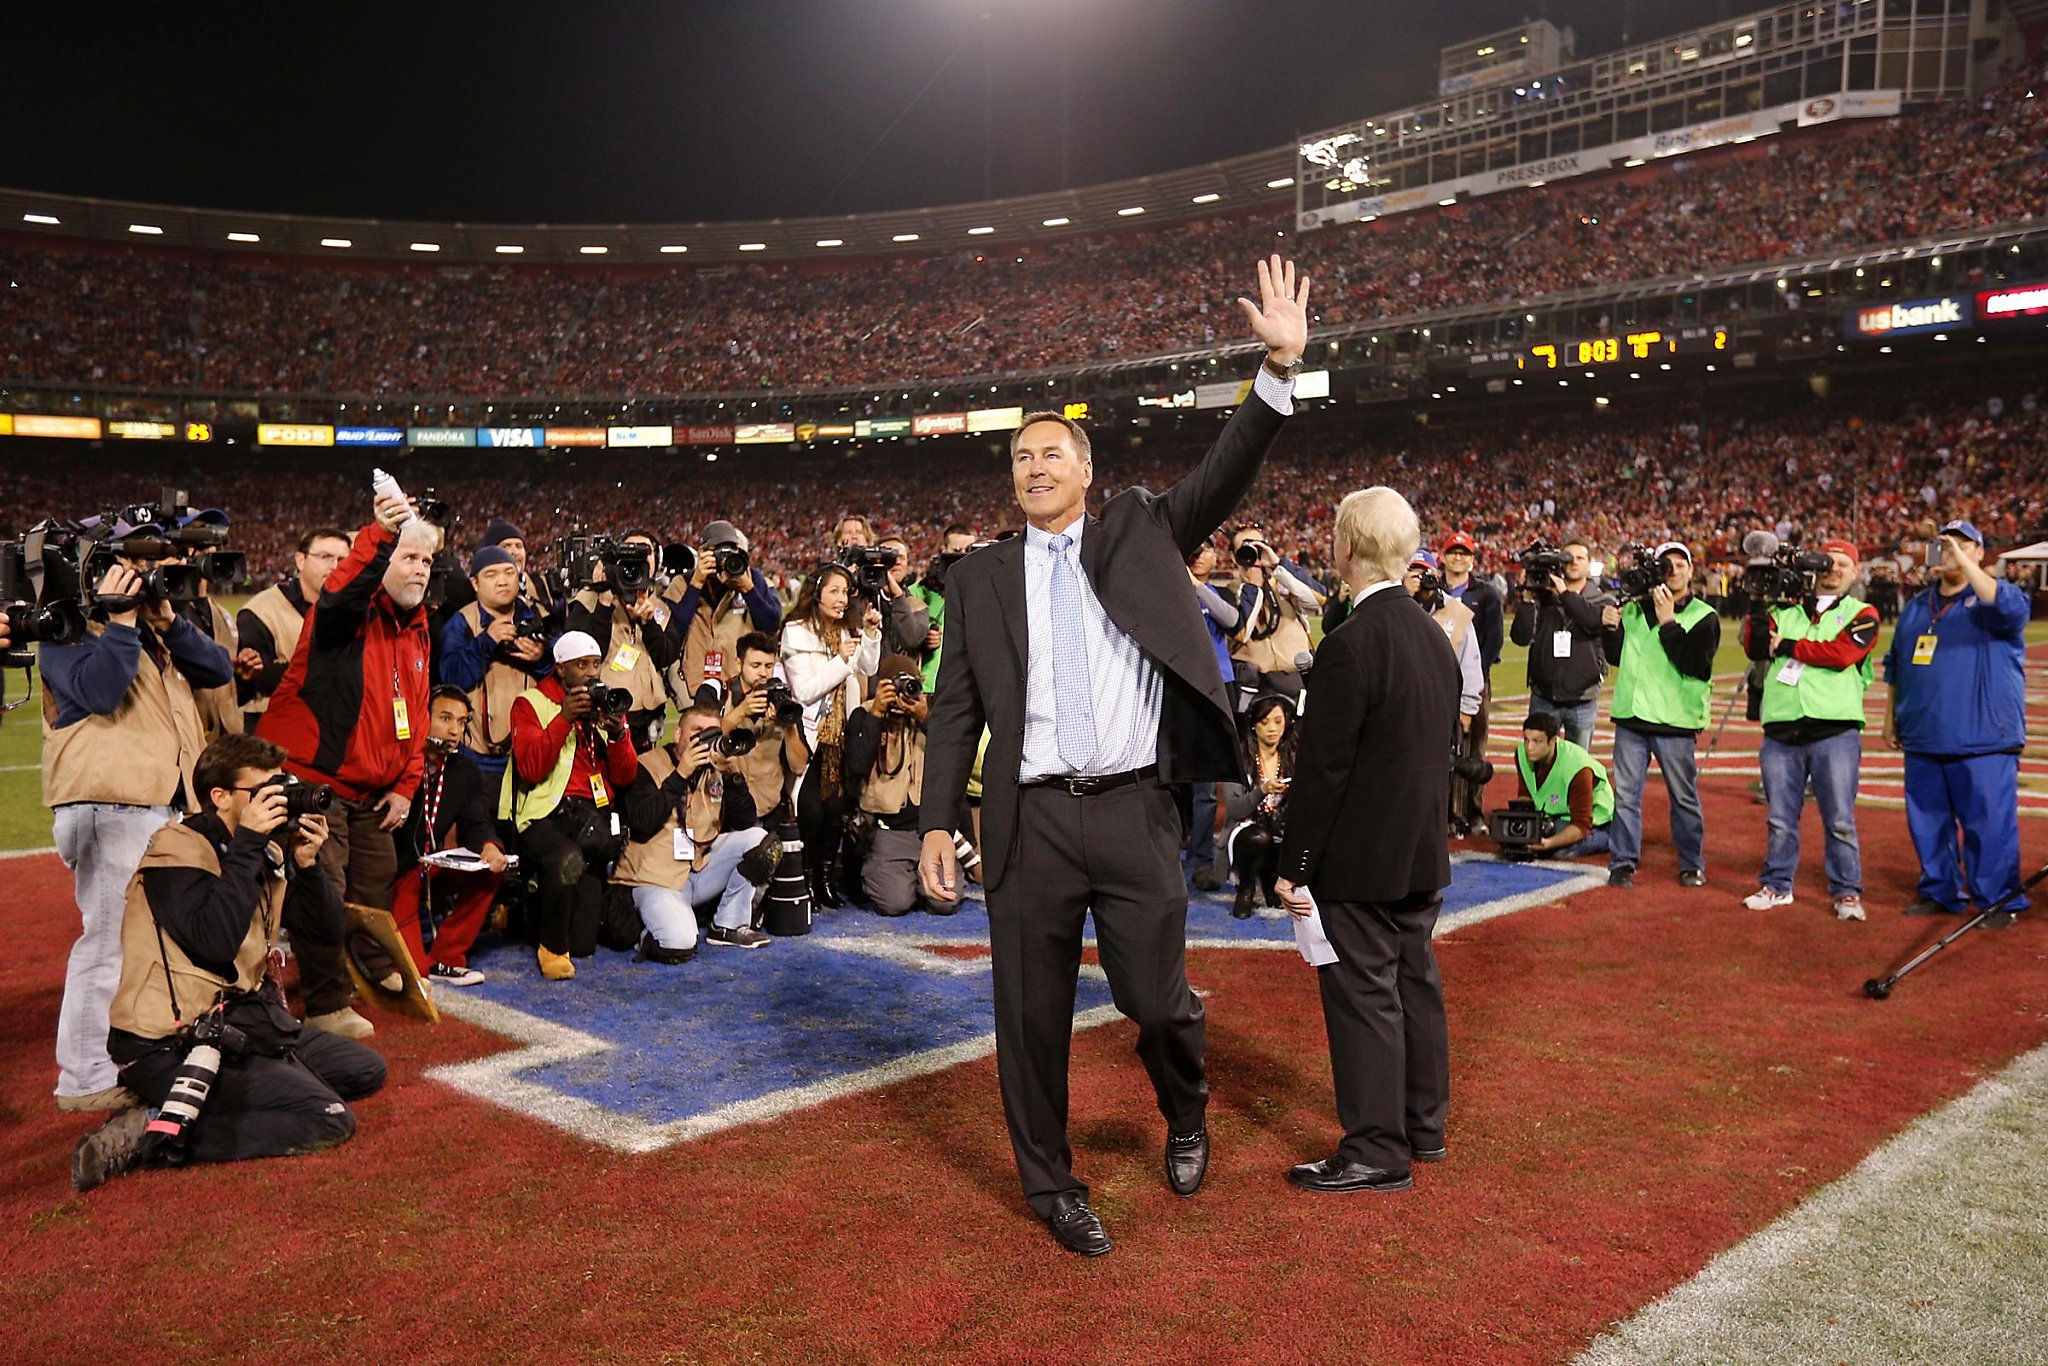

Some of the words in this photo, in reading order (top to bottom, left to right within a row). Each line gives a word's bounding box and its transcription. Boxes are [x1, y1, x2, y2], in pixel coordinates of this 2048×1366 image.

[1579, 340, 1618, 364] 8:03
[489, 428, 534, 447] VISA
[688, 426, 733, 439] SanDisk
